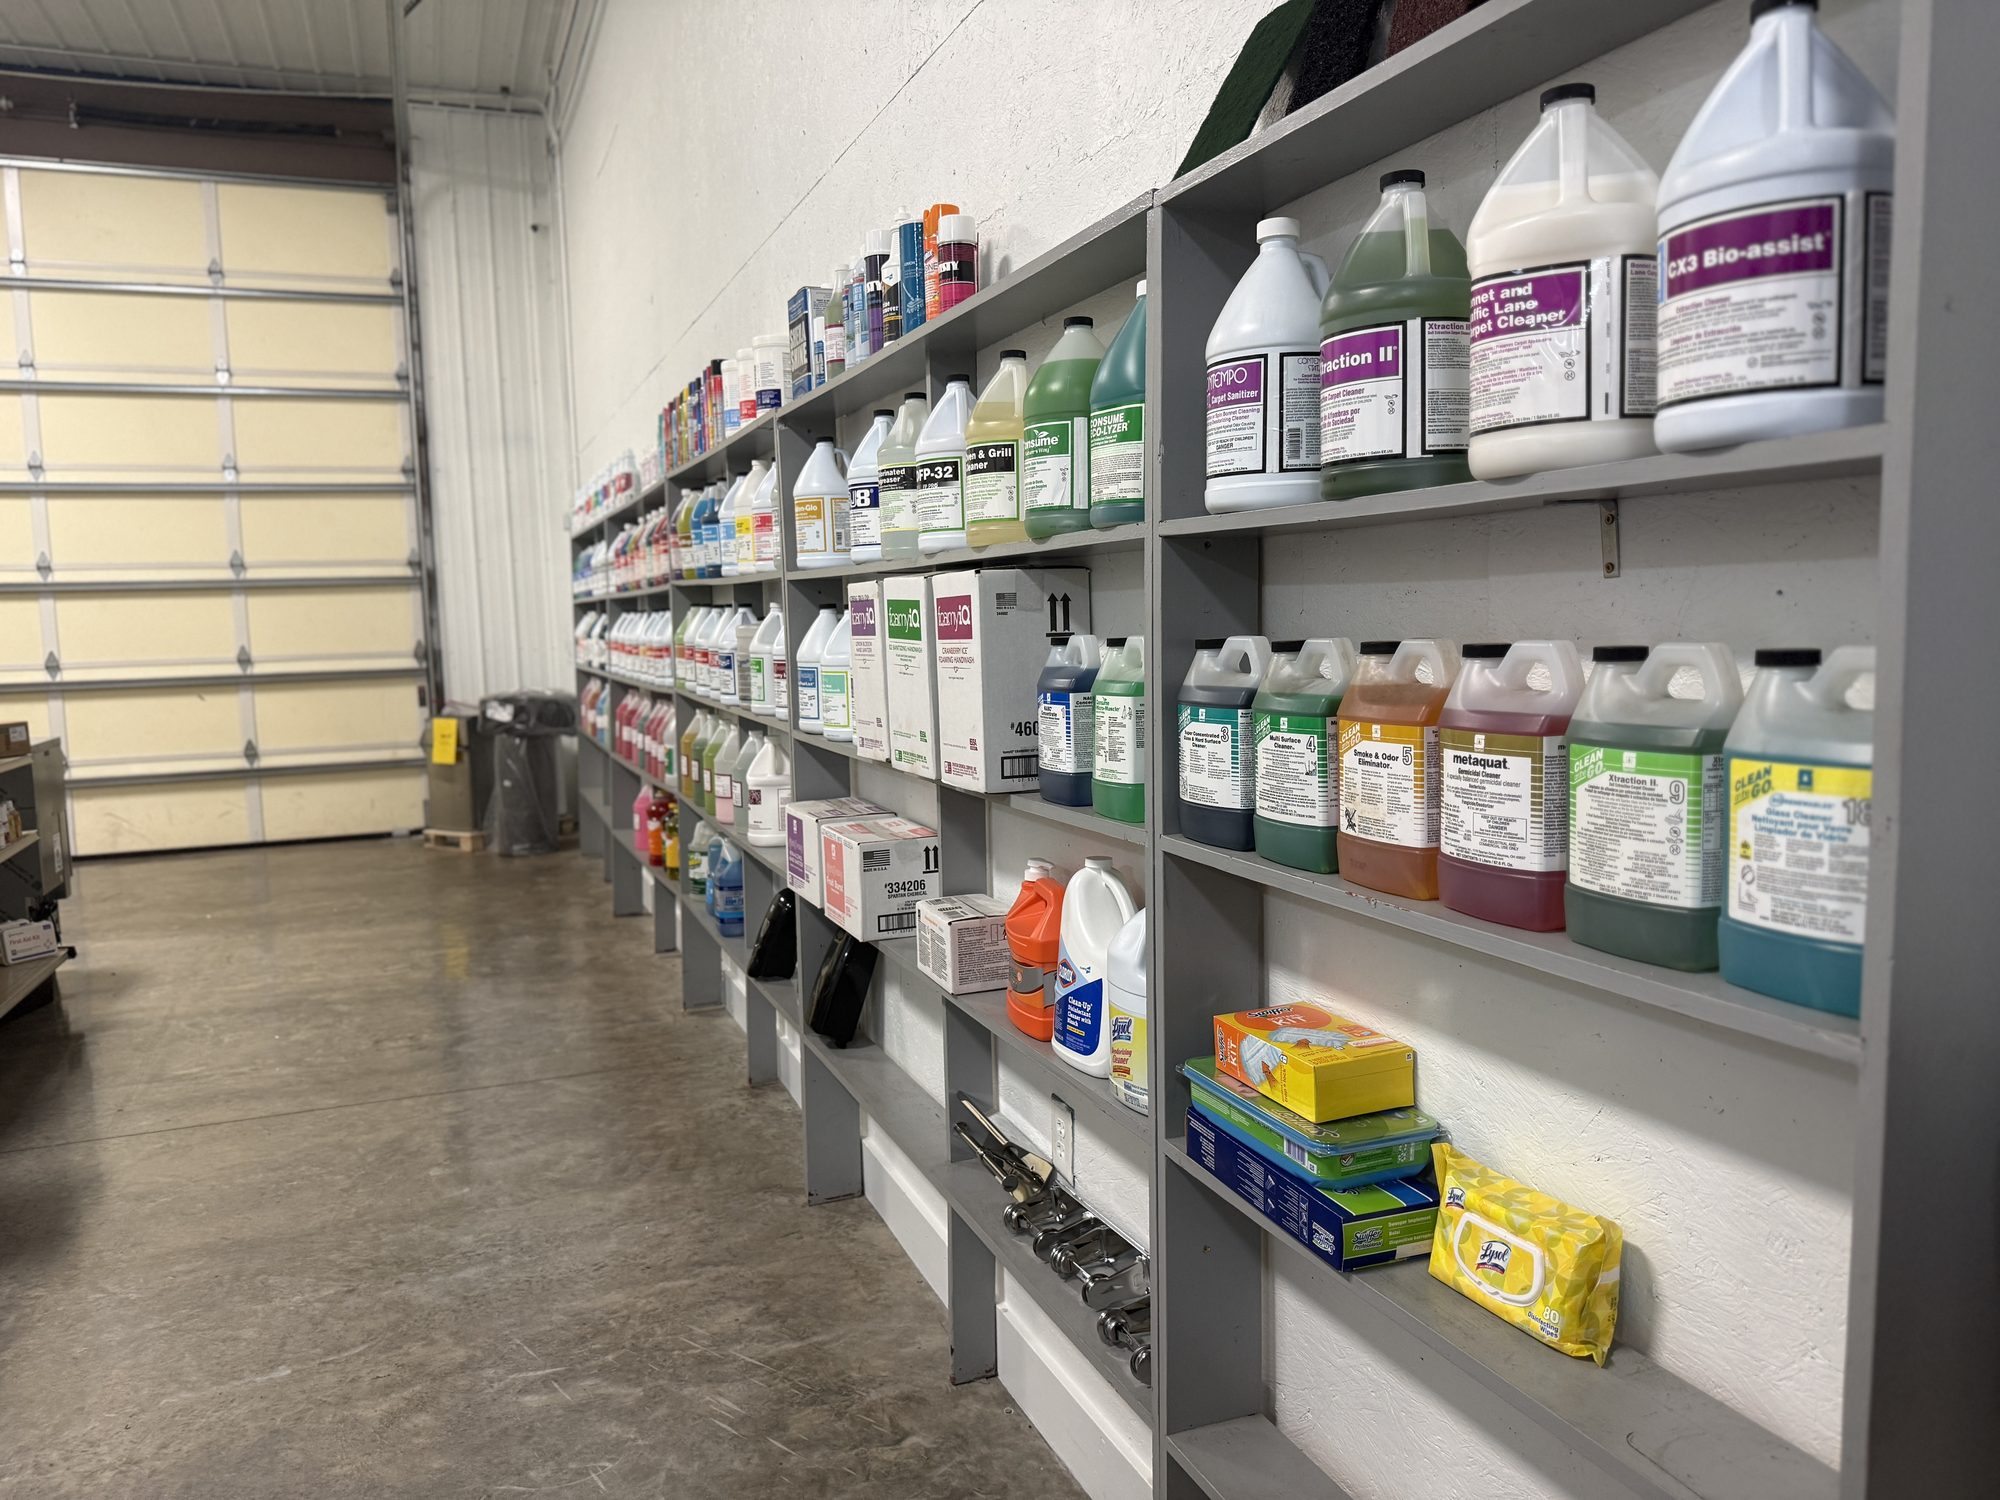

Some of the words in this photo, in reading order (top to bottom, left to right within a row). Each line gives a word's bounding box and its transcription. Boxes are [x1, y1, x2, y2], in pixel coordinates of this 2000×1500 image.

[1668, 256, 1697, 279] CX3
[1704, 233, 1824, 268] Bio-assist
[1500, 283, 1532, 298] and
[1495, 299, 1538, 315] Lane
[1497, 309, 1565, 327] Cleaner
[1321, 352, 1372, 375] traction
[1211, 395, 1226, 404] Carpet
[1228, 390, 1258, 401] Sanitizer
[1328, 390, 1342, 399] Carpet
[1343, 387, 1365, 396] Cleaner
[1350, 407, 1360, 417] por
[1332, 417, 1354, 425] Suciedad
[978, 450, 985, 460] &
[988, 448, 1012, 458] Grill
[850, 489, 871, 507] J8
[851, 607, 874, 629] foamyiQ
[889, 608, 920, 633] foamyiQ
[938, 605, 970, 632] foamyiQ
[942, 647, 961, 655] CRANBERRY
[954, 656, 974, 664] HANDWASH
[1221, 726, 1229, 742] 3
[1342, 723, 1360, 741] CLEAN
[1351, 733, 1360, 746] GO
[1306, 736, 1316, 753] 4
[1354, 749, 1373, 758] Smoke
[1382, 753, 1399, 762] Odor
[1402, 747, 1412, 765] 5
[1453, 754, 1508, 769] metaquat
[1575, 748, 1604, 772] CLEAN
[1358, 758, 1390, 769] Eliminator
[1587, 761, 1603, 779] GO
[1458, 768, 1480, 777] Germicidal
[1482, 771, 1501, 779] Cleaner
[1462, 775, 1479, 783] balanced
[1480, 778, 1502, 786] germicidal
[1609, 774, 1647, 785] Xtraction
[1735, 765, 1772, 791] CLEAN
[1669, 780, 1684, 805] 9
[1751, 779, 1772, 797] GO
[1766, 808, 1791, 818] Glass
[1794, 811, 1832, 822] Cleaner
[1752, 815, 1794, 827] Nettoyant
[1797, 822, 1819, 831] pour
[1754, 825, 1797, 837] Limpiador
[885, 879, 926, 893] #334206
[1068, 996, 1091, 1012] Clean-Up
[1068, 1005, 1091, 1017] Disinfectant
[1067, 1012, 1081, 1022] Cleaner
[1082, 1017, 1092, 1025] with
[1247, 1008, 1293, 1018] Swiffer
[1272, 1015, 1306, 1026] KIT
[1067, 1018, 1078, 1027] Bleach
[1112, 1017, 1132, 1036] Lysol
[1448, 1188, 1464, 1202] Lysol
[1352, 1226, 1382, 1243] Swiffer
[1353, 1239, 1383, 1251] Professional
[1480, 1241, 1508, 1262] Lysol
[1528, 1311, 1559, 1333] Disinfecting
[1543, 1306, 1559, 1324] 80
[1540, 1326, 1558, 1338] Wipes
